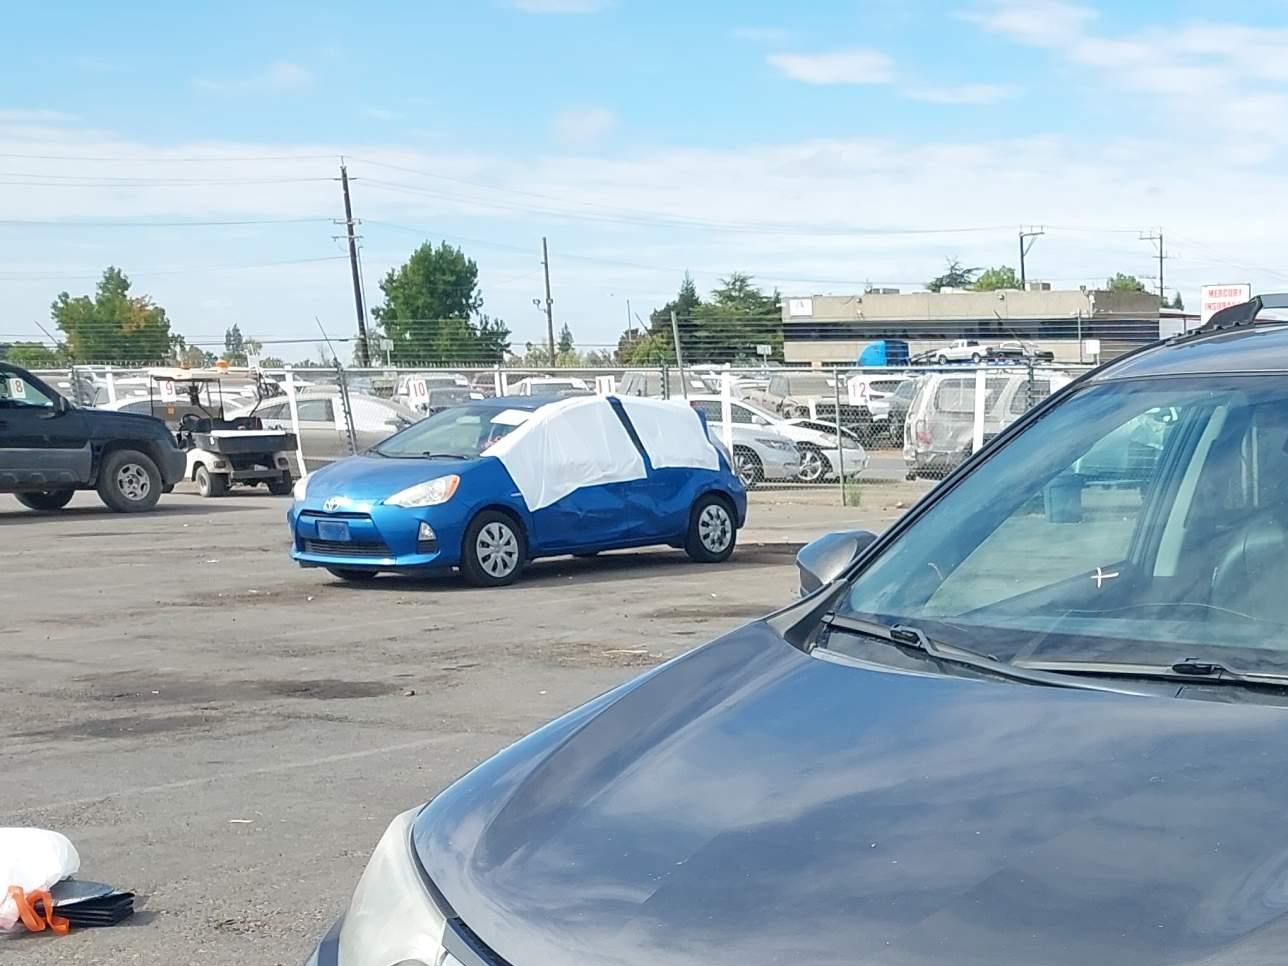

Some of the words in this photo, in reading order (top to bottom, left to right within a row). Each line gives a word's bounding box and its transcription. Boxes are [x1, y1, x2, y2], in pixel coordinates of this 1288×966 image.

[15, 380, 23, 394] 8
[412, 382, 426, 397] 10
[852, 382, 867, 398] 12
